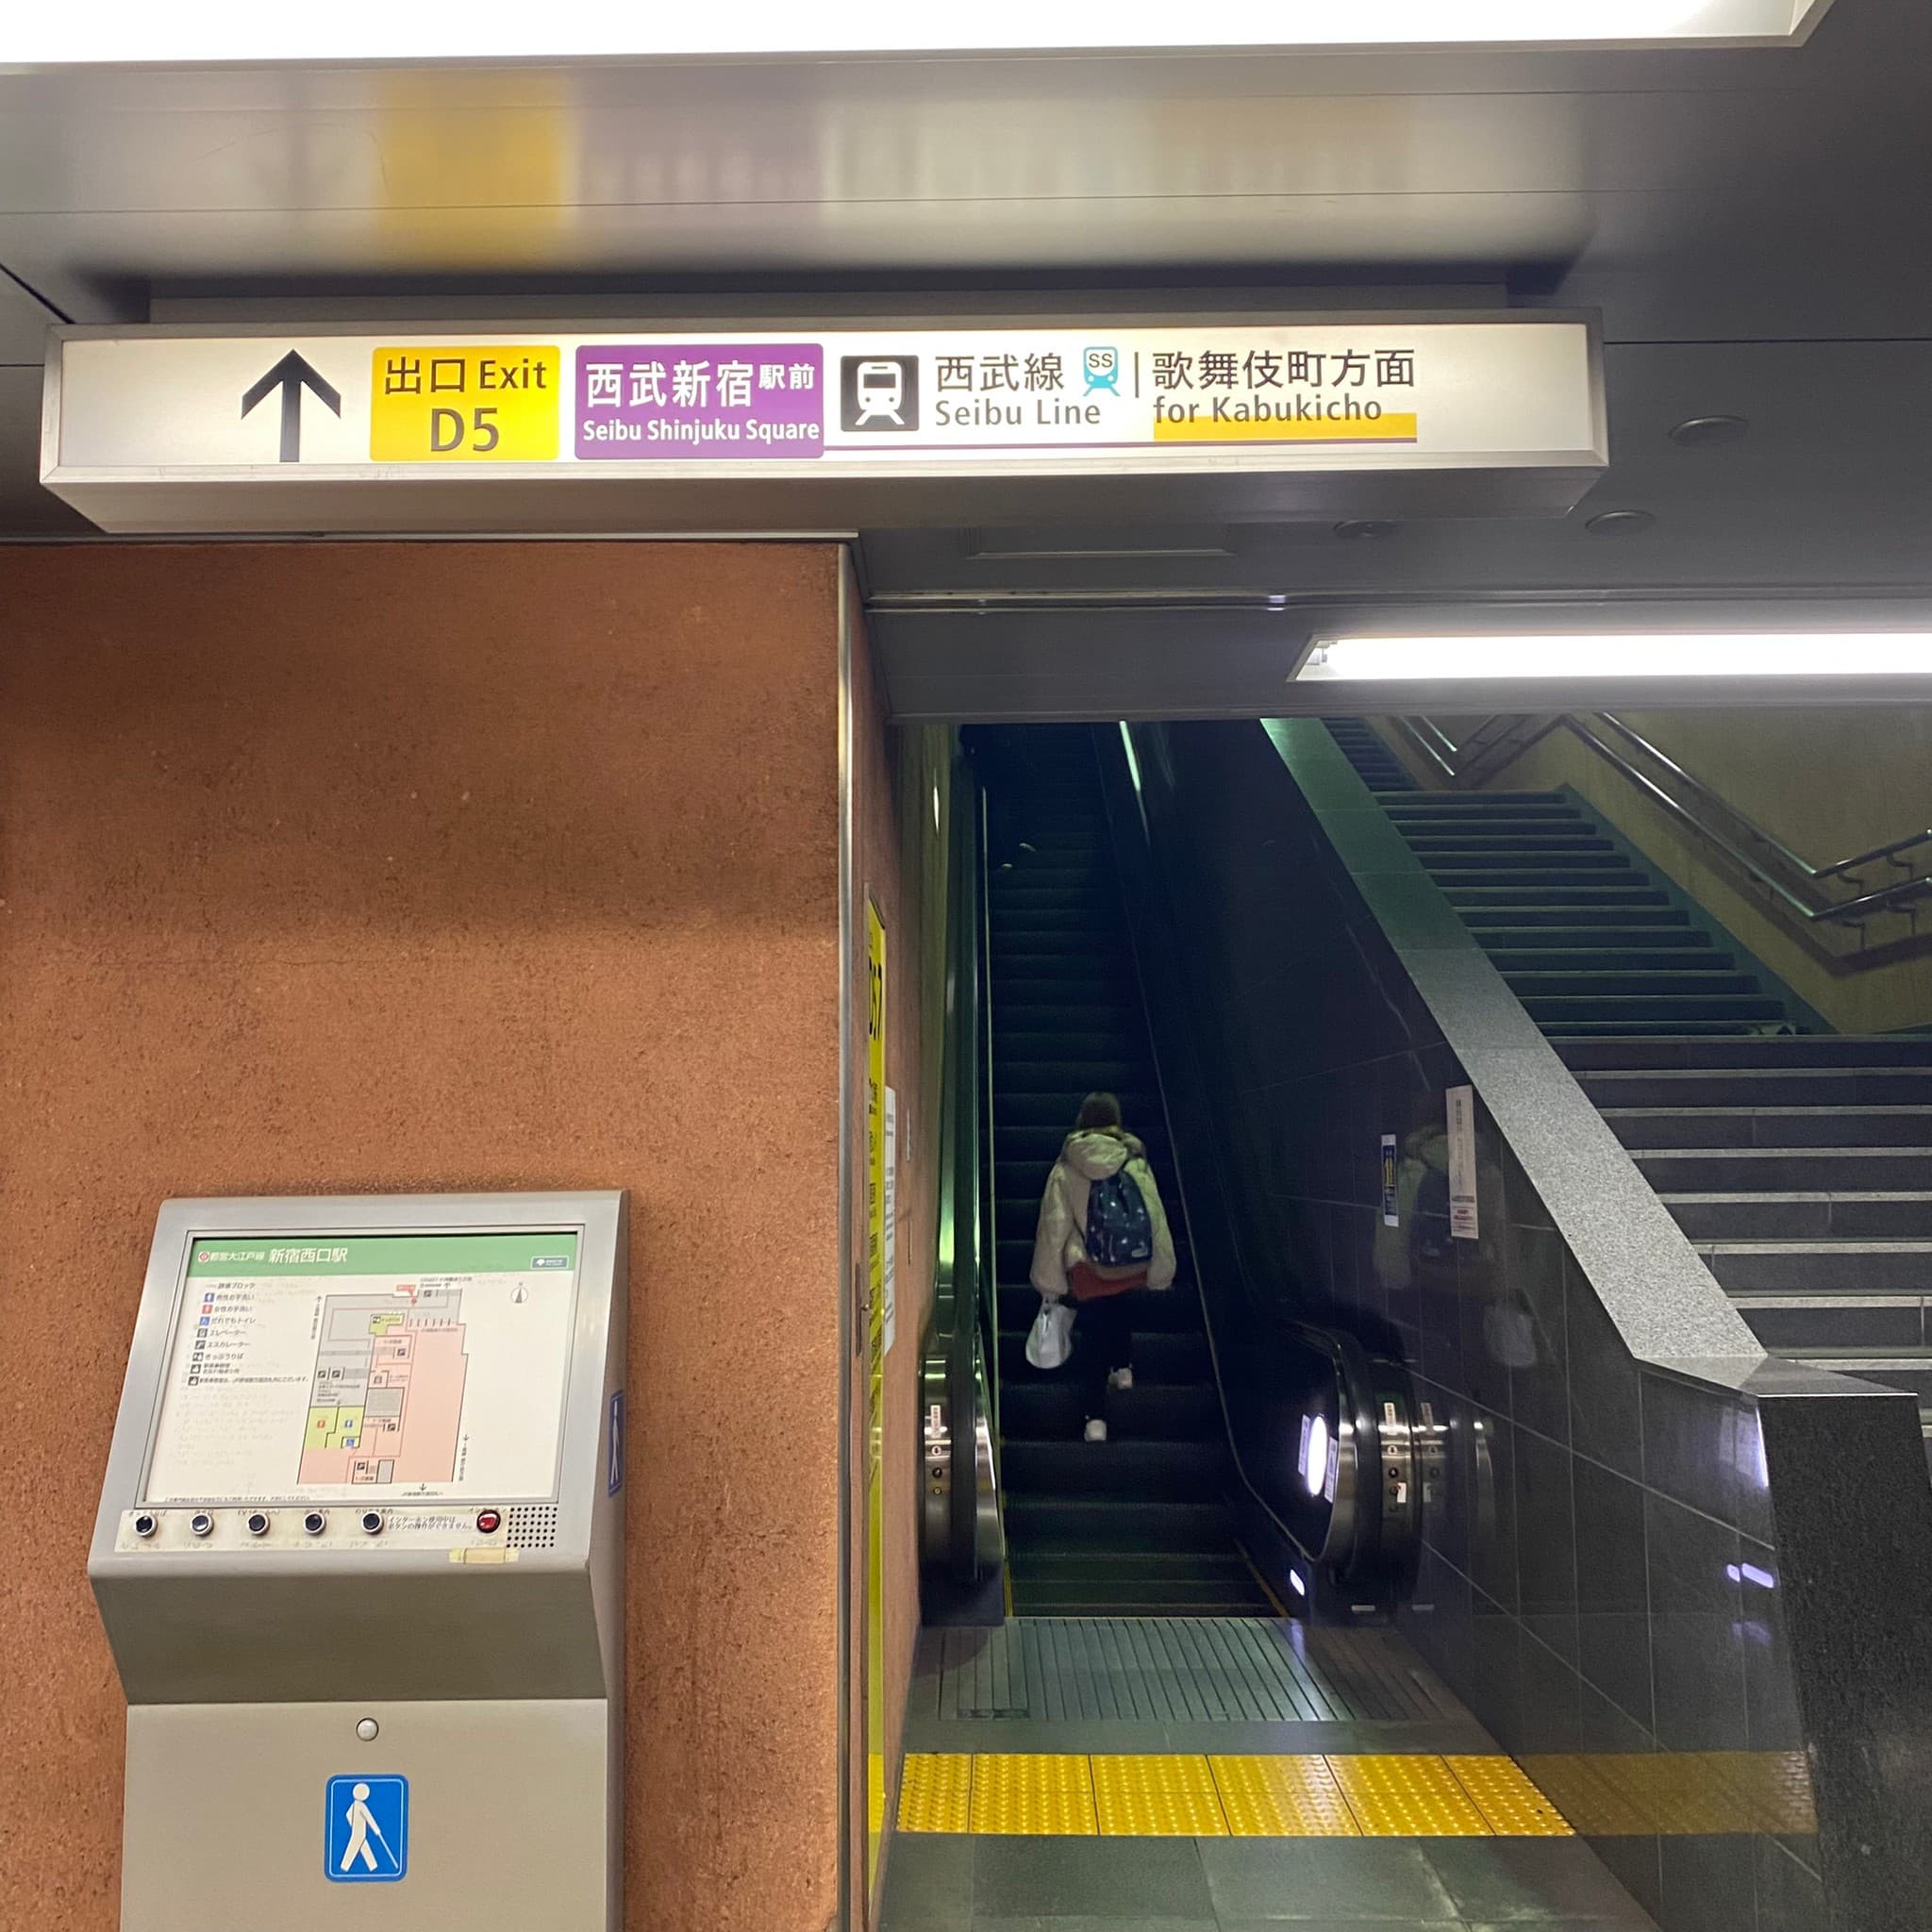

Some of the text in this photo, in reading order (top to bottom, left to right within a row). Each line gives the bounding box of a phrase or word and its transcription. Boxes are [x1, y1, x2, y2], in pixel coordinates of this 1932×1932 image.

[384, 356, 546, 395] 出口 Exit
[935, 352, 1065, 392] 西武線
[1088, 352, 1113, 368] SS
[1152, 348, 1415, 390] 歌舞伎町方面
[586, 358, 814, 408] 西武新宿駅前
[935, 397, 1101, 426] Seibu Line
[1154, 393, 1382, 424] for Kabukicho
[430, 407, 499, 452] D5
[583, 418, 819, 445] Seibu Shinjuku Square
[268, 1247, 348, 1264] 新宿西口駅
